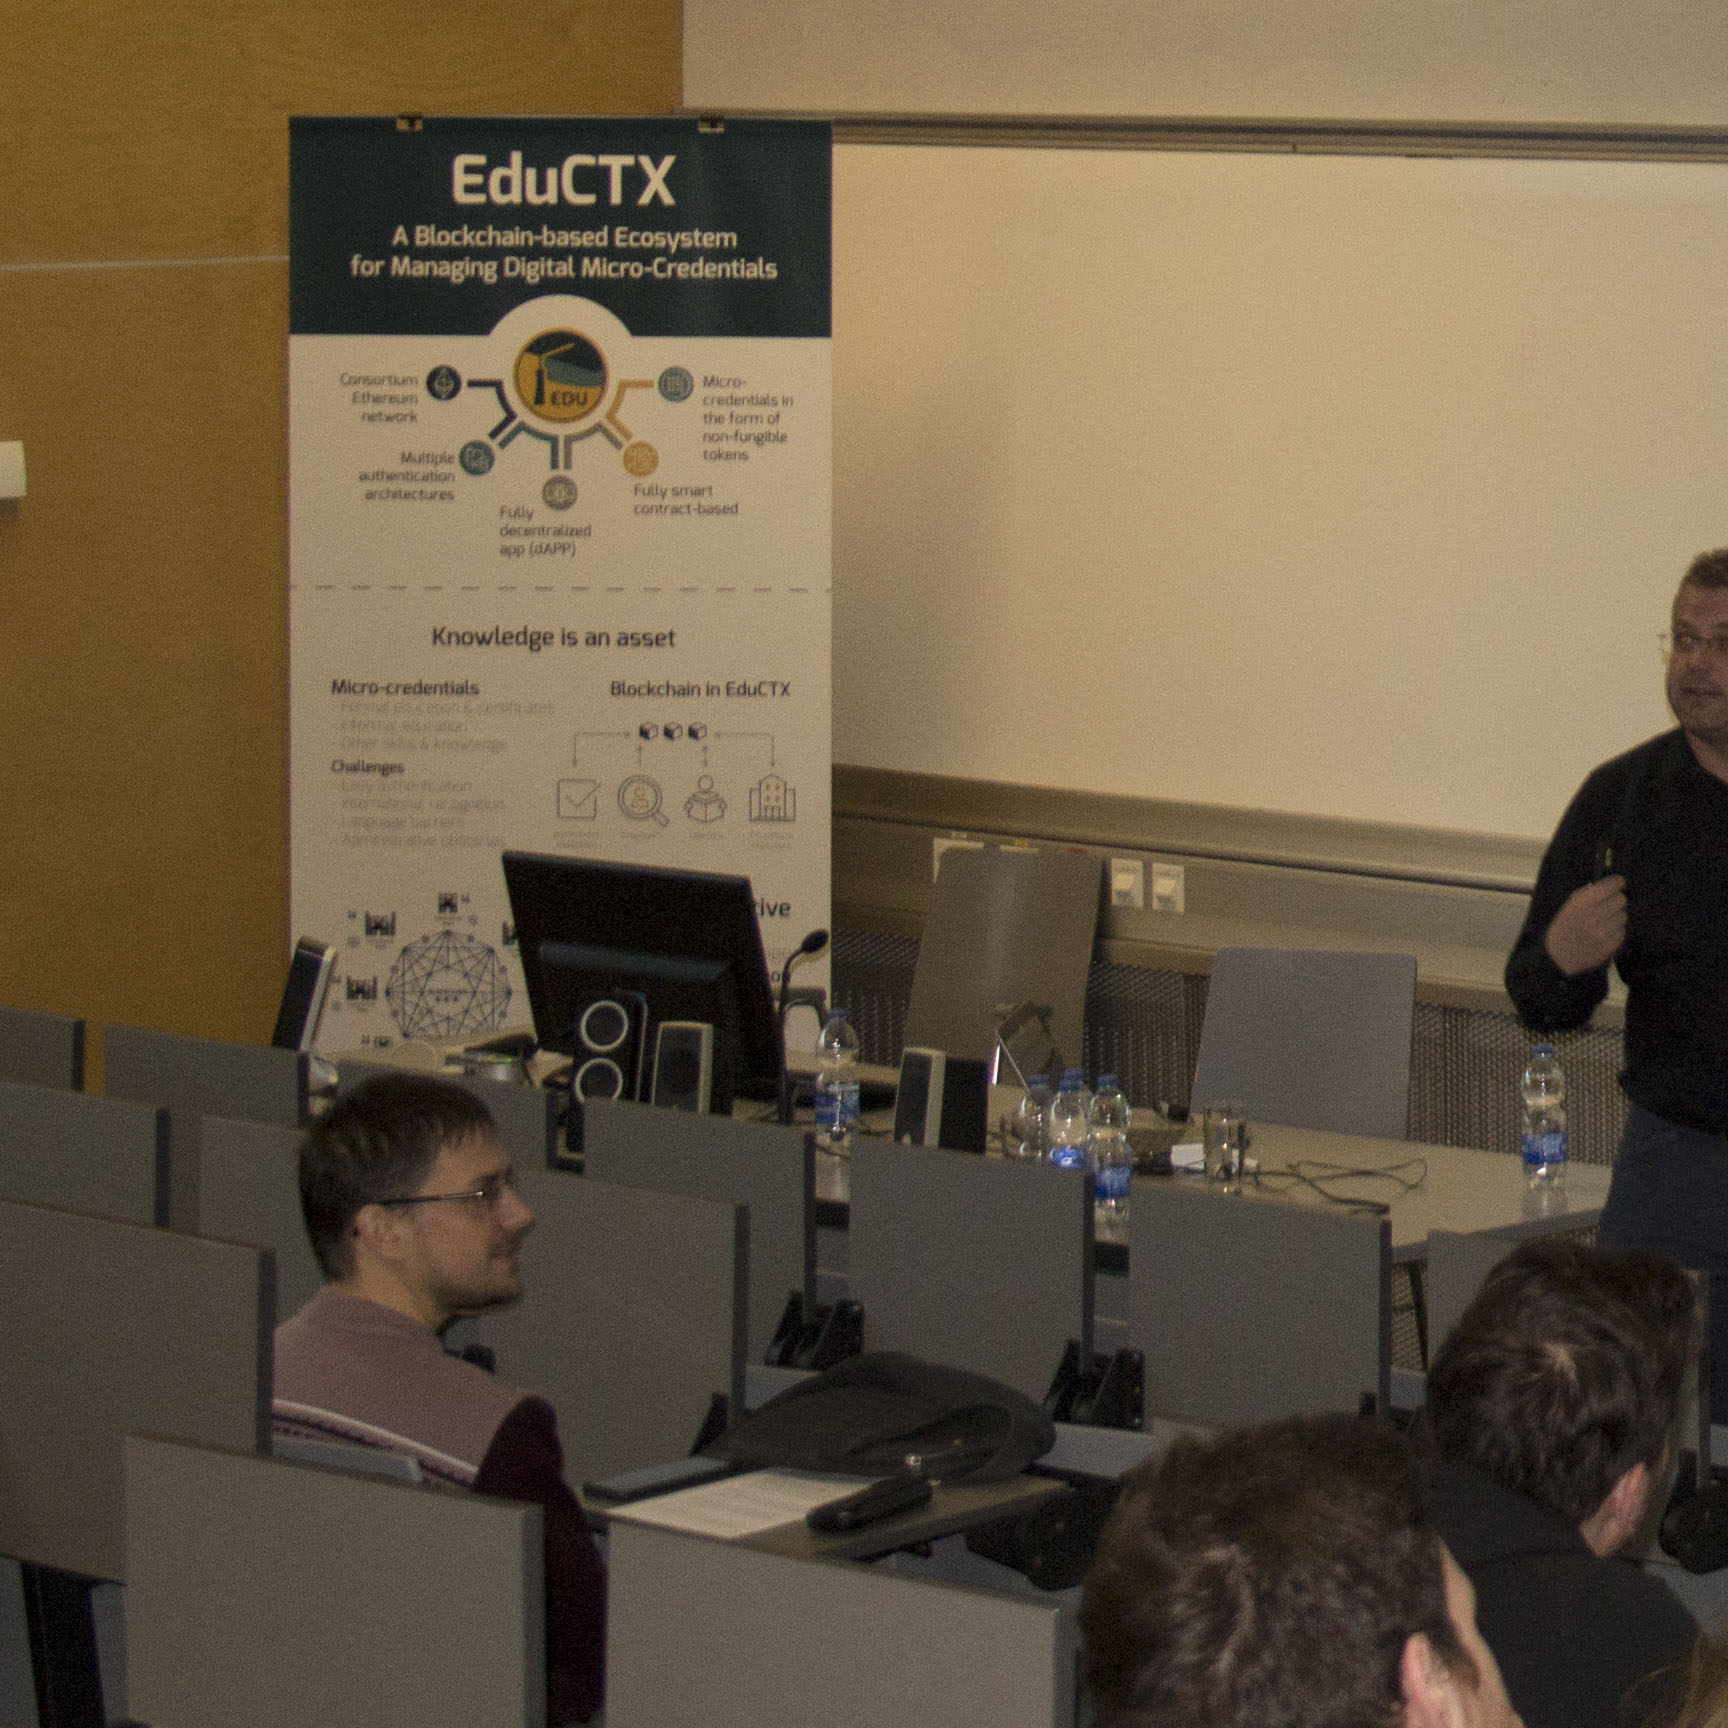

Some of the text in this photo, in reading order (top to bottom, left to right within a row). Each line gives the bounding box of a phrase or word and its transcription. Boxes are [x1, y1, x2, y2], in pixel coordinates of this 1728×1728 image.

[452, 151, 676, 206] EduCTX
[392, 225, 738, 253] A Blockchain-based Ecosystem
[351, 254, 778, 284] for Managing Digital Micro-Credentials
[340, 372, 419, 387] Consortium
[702, 375, 747, 388] Micro-
[352, 391, 419, 405] Ethereum
[551, 391, 588, 407] EDU
[703, 394, 794, 407] credentials in
[362, 410, 418, 423] network
[703, 410, 781, 424] the form of
[703, 429, 788, 448] non-fungible
[401, 451, 455, 466] Multiple
[703, 448, 749, 462] tokens
[358, 470, 455, 483] authentication
[364, 488, 455, 502] architectures
[633, 483, 713, 500] Fully smart
[500, 504, 534, 521] Fully
[633, 502, 740, 516] contract-based
[500, 524, 593, 538] decentralized
[500, 544, 525, 559] app
[431, 625, 677, 653] Knowledge is an asset
[331, 678, 481, 697] Micro-credentials
[609, 680, 791, 699] Blockchain in EduCTX
[331, 758, 405, 778] Challenges
